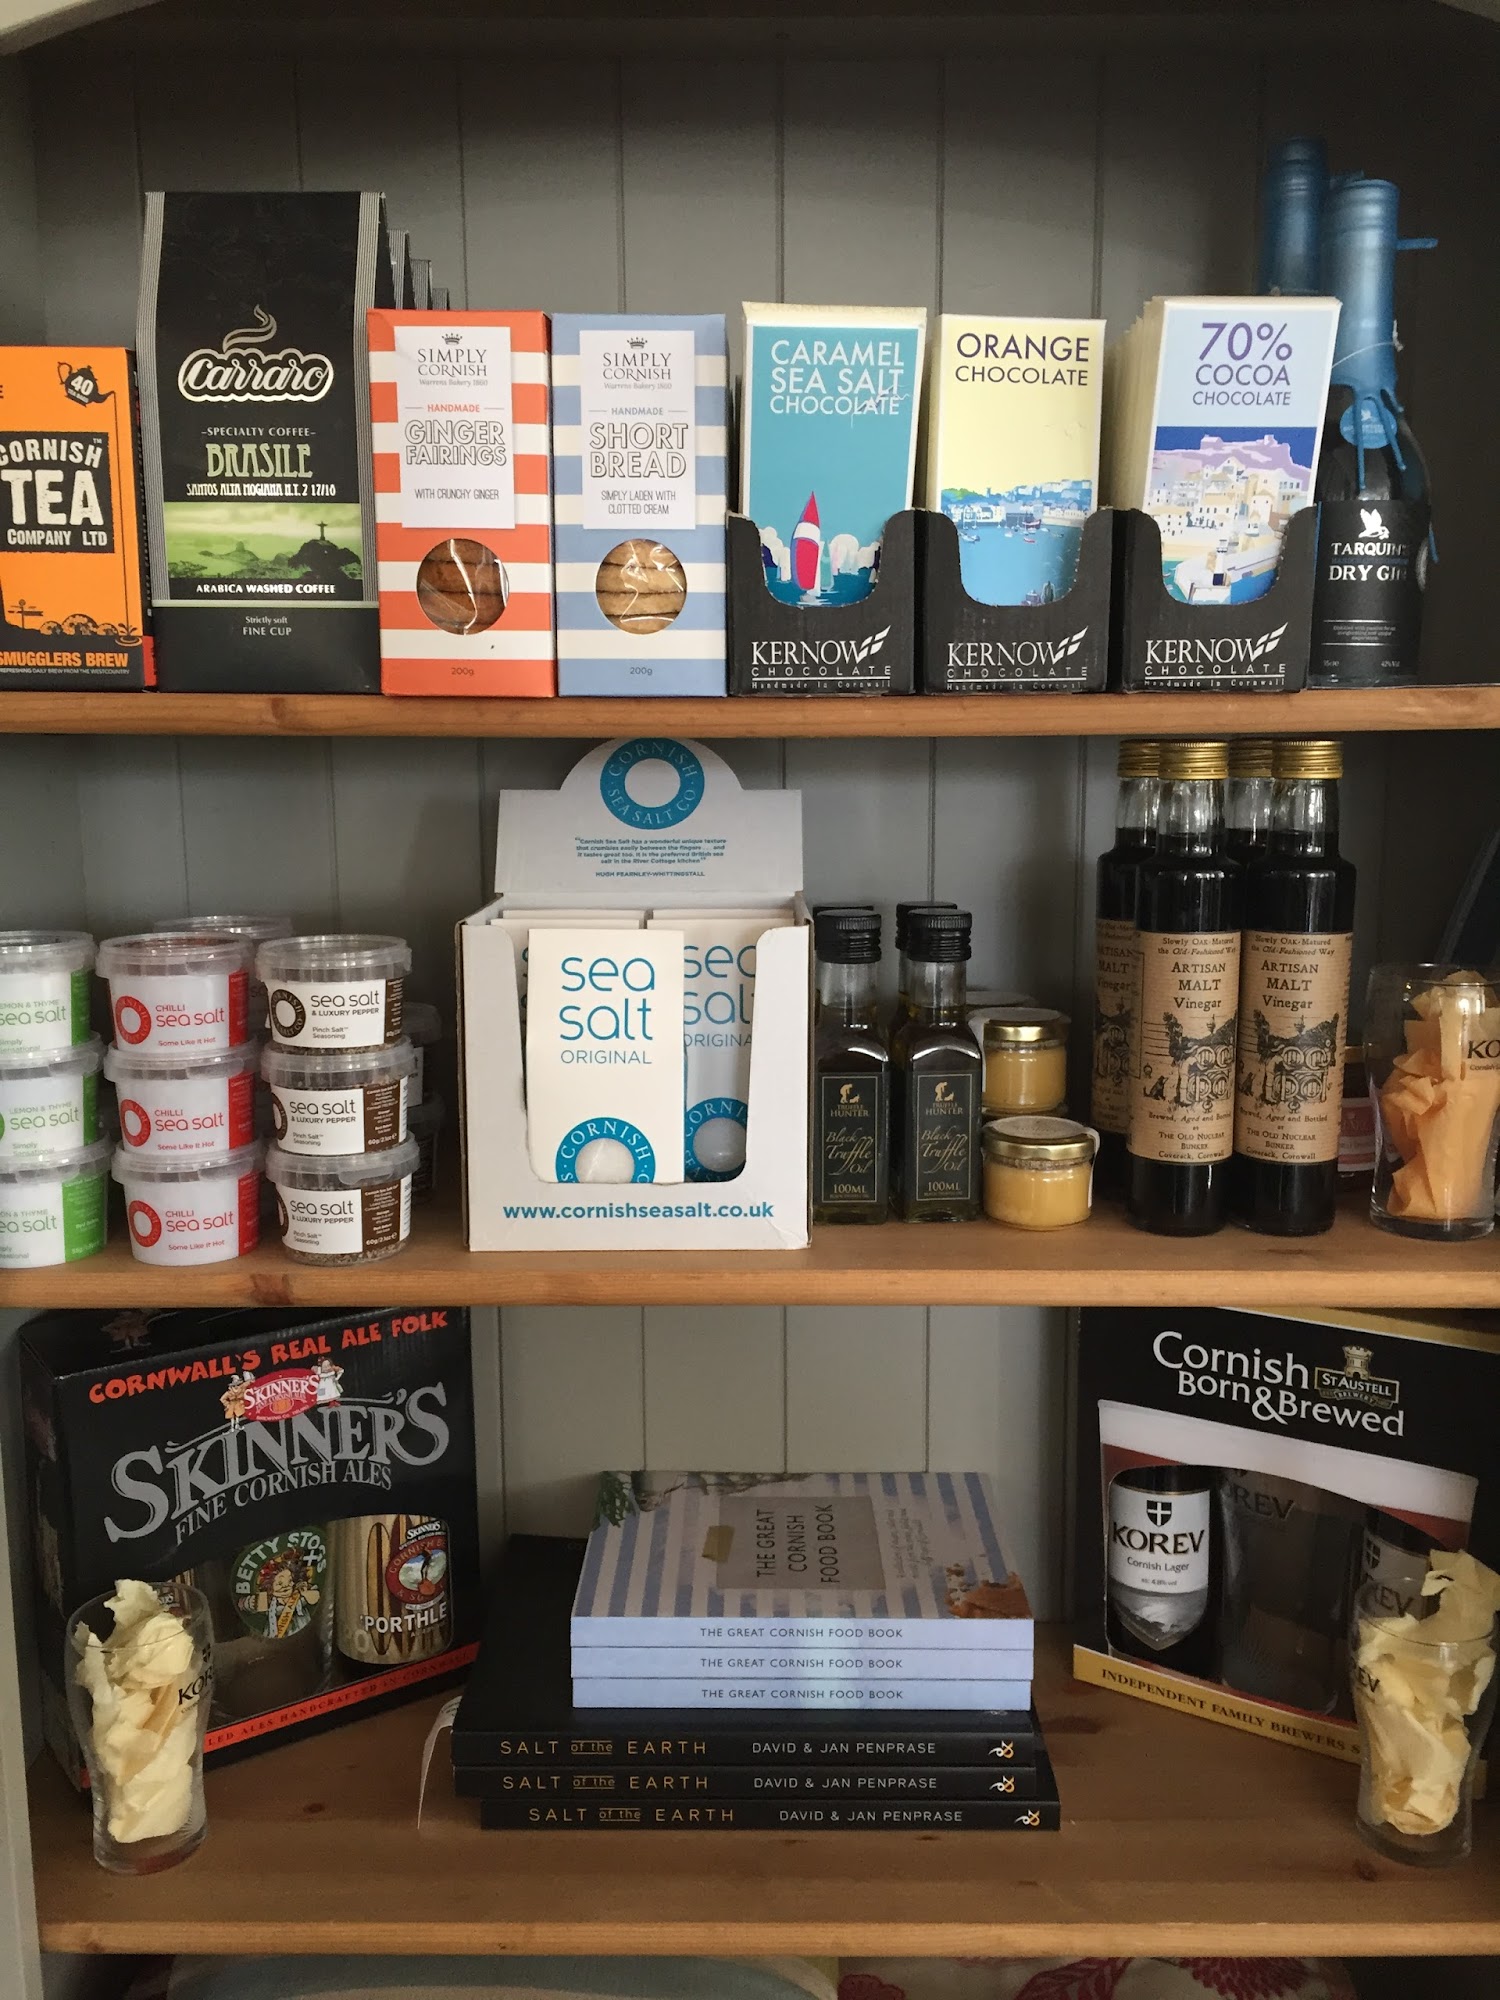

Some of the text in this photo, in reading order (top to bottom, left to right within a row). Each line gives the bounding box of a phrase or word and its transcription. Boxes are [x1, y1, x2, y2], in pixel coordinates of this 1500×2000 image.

[956, 332, 1090, 362] ORANGE
[1198, 322, 1293, 361] 70%
[417, 348, 487, 363] SIMPLY
[602, 352, 672, 367] SIMPLY
[770, 339, 905, 367] CARAMEL
[417, 364, 487, 378] CORNISH
[602, 368, 672, 381] CORNISH
[955, 365, 1089, 386] CHOCOLATE
[1195, 364, 1291, 386] COCOA
[70, 375, 95, 396] 40
[770, 366, 905, 395] SEA SALT
[769, 395, 900, 415] CHOCOLATE
[1192, 391, 1292, 406] CHOCOLATE
[427, 404, 480, 413] HANDMADE
[611, 407, 664, 416] HANDMADE
[405, 419, 506, 446] GINGER
[589, 422, 689, 450] SHORT
[0, 438, 103, 468] CORNISH
[205, 442, 314, 479] BRASILE
[405, 445, 507, 467] FAIRINGS
[590, 450, 688, 479] BREAD
[0, 468, 105, 526] TEA
[414, 488, 500, 500] WITH CRUNCHY GINGER
[7, 529, 108, 546] COMPANY LTD
[1328, 564, 1374, 581] DRY
[196, 584, 336, 595] ARABICA WASHED COFFEE
[245, 615, 273, 626] Strictly
[243, 626, 292, 636] FINE CUP
[0, 651, 129, 668] SMUGGLERS BREW
[751, 639, 867, 665] KERNOW
[947, 641, 1063, 667] KERNOW
[1145, 638, 1261, 664] KERNOW
[751, 665, 892, 677] CHOCOLATE
[946, 666, 1088, 679] CHOCOLATE
[1144, 663, 1286, 676] CHOCOLATE
[608, 741, 698, 778] CORNISH
[608, 787, 697, 826] SEA SALT CO
[560, 956, 656, 992] sea
[1170, 961, 1227, 974] ARTISAN
[1260, 959, 1319, 974] ARTISAN
[1178, 978, 1222, 991] MALT
[1266, 977, 1313, 992] MALT
[310, 990, 381, 1008] sea salt
[1172, 996, 1223, 1012] Vinegar
[1261, 994, 1313, 1012] Vinegar
[155, 1003, 186, 1013] CHILLI
[155, 1006, 226, 1028] sea salt
[558, 997, 654, 1041] salt
[560, 1049, 653, 1065] ORIGINAL
[154, 1109, 184, 1117] CHILLI
[289, 1099, 357, 1116] sea salt
[830, 1109, 869, 1117] HUNTER
[925, 1107, 964, 1116] HUNTER
[9, 1115, 46, 1131] sea
[155, 1112, 224, 1132] sea salt
[560, 1119, 651, 1161] CORNISH
[1262, 1130, 1316, 1141] OLD NUCLEAR
[833, 1183, 868, 1194] 100ML
[927, 1181, 962, 1192] 100ML
[165, 1209, 195, 1218] CHILLI
[289, 1200, 355, 1216] sea salt
[502, 1201, 775, 1219] www.cornishseasalt.co.uk
[166, 1210, 234, 1233] sea salt
[88, 1348, 262, 1405] CORNWALL'S
[270, 1335, 332, 1367] REAL
[341, 1321, 383, 1350] ALE
[391, 1311, 449, 1339] FOLK
[1152, 1330, 1310, 1390] Cornish
[1337, 1376, 1392, 1397] AUSTELL
[103, 1381, 451, 1544] SKINNER'S
[174, 1460, 393, 1546] FINE CORNISH ALES
[756, 1508, 776, 1578] THE GREAT
[787, 1514, 807, 1573] CORNISH
[814, 1503, 841, 1584] FOOD BOOK
[1112, 1521, 1206, 1556] KOREV
[235, 1536, 281, 1594] BETTY
[1126, 1556, 1190, 1574] Cornish Lager
[700, 1627, 904, 1639] THE GREAT CORNISH FOOD BOOK
[700, 1658, 904, 1669] THE GREAT CORNISH FOOD BOOK
[280, 1683, 378, 1723] HANDCRAFTED
[701, 1689, 904, 1700] THE GREAT CORNISH FOOD BOOK
[1101, 1667, 1207, 1710] INDEPENDENT
[1212, 1703, 1266, 1729] FAMILY
[1270, 1720, 1346, 1751] BREWERS
[500, 1740, 706, 1755] SALT of the EARTH
[751, 1742, 936, 1754] DAVID & JAN PENPRASE
[502, 1775, 708, 1790] SALT of the EARTH
[753, 1777, 938, 1789] DAVID & JAN PENPRASE
[529, 1808, 733, 1822] SALT of the EARTH
[779, 1810, 963, 1822] DAVID & JAN PENPRASE
